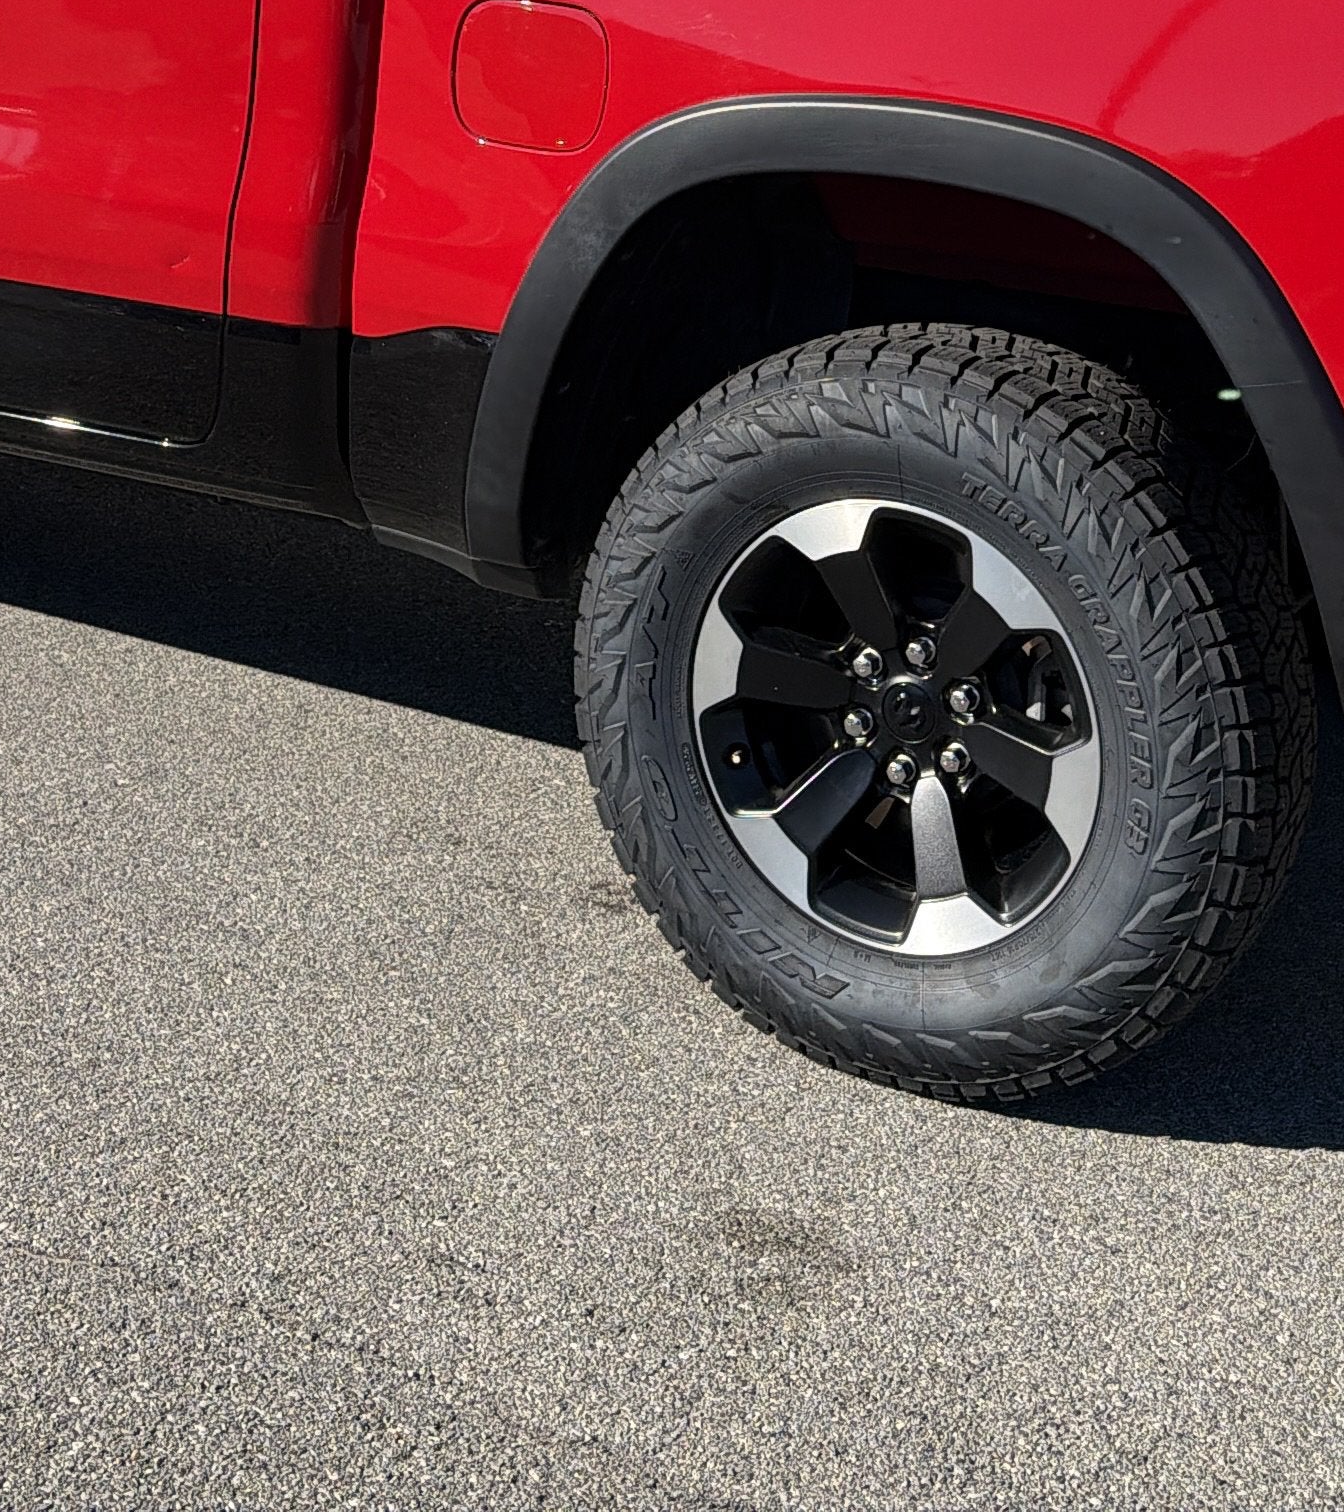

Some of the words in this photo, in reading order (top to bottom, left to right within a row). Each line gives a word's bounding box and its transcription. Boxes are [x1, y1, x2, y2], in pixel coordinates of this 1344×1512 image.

[960, 472, 1069, 573] TERRA
[1067, 574, 1154, 791] GRAPPLER
[1124, 797, 1153, 857] G3
